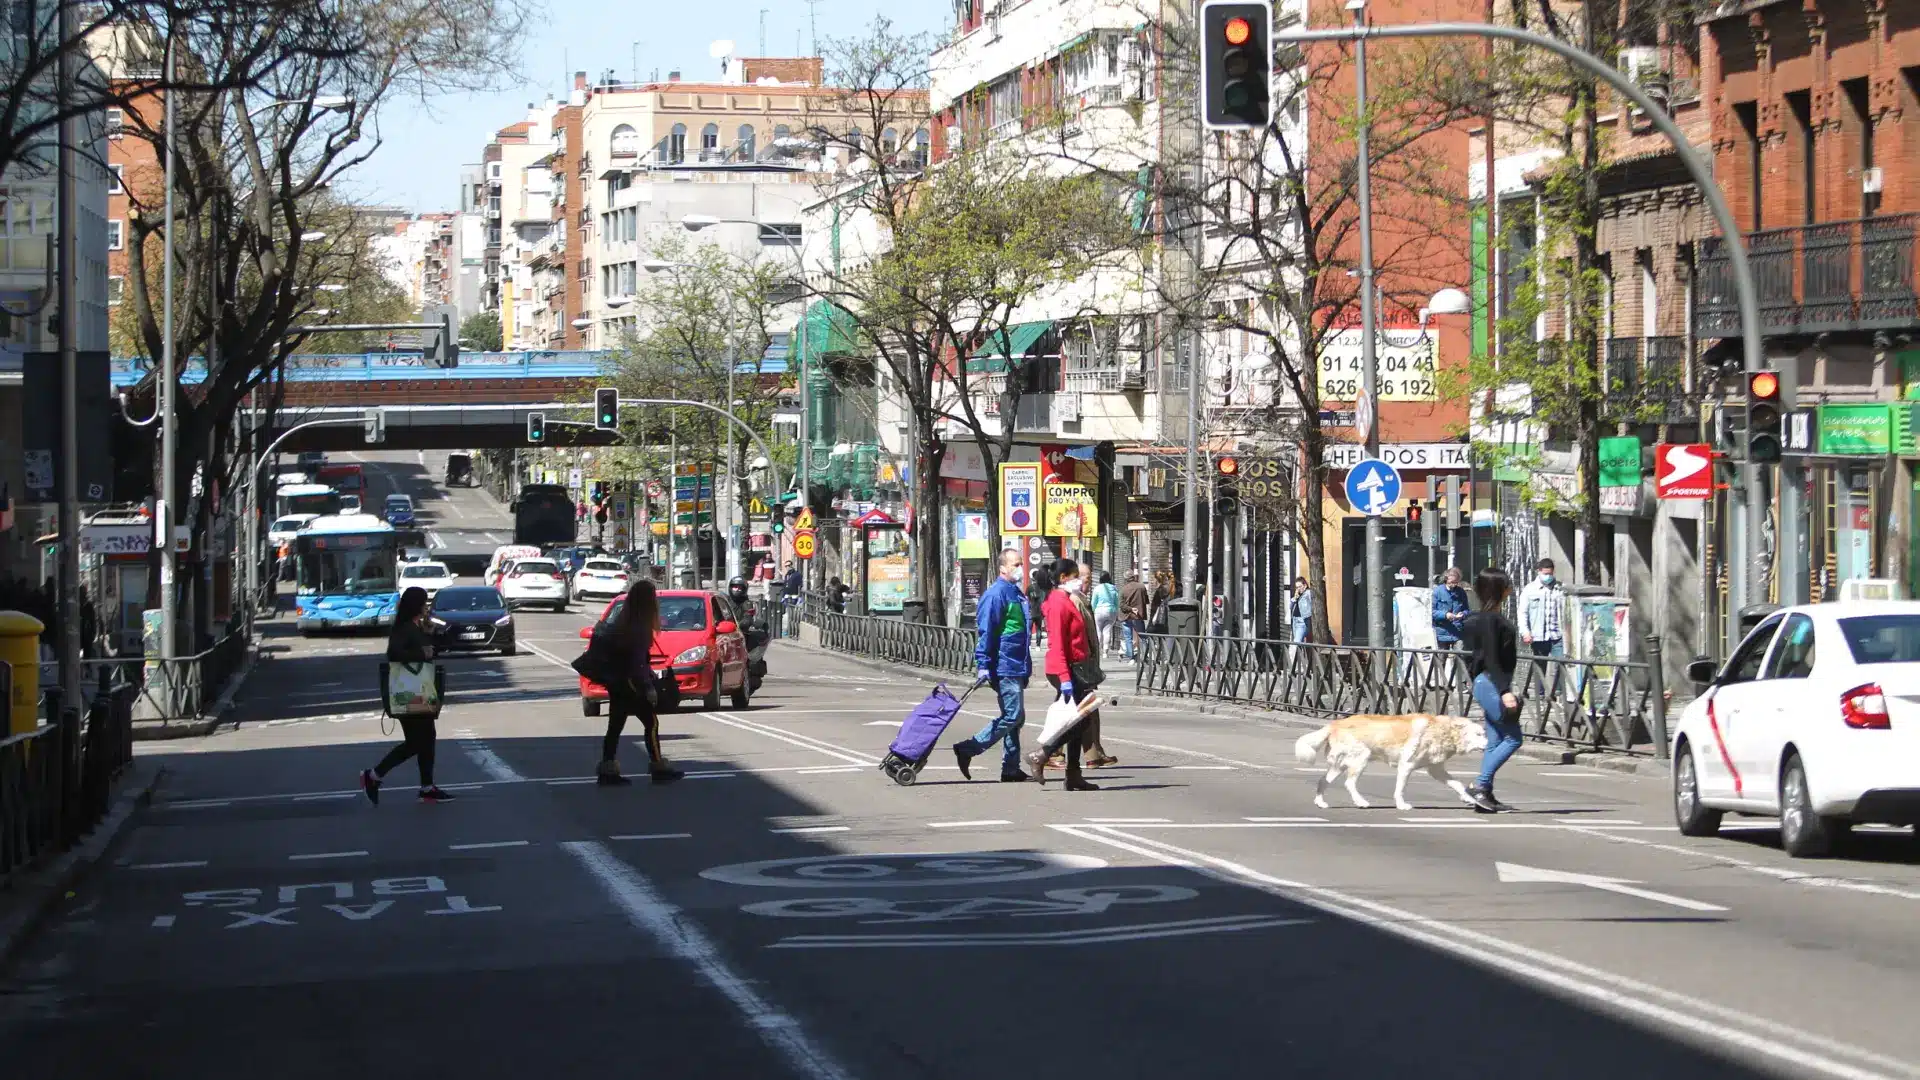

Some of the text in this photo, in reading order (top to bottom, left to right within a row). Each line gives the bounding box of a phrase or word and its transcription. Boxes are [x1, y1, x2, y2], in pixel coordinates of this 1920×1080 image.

[1402, 311, 1436, 325] PISS
[1323, 356, 1341, 371] 91
[1387, 356, 1407, 371] 04
[1326, 379, 1357, 395] 626
[1401, 379, 1431, 395] 192
[1334, 449, 1427, 464] HELDOS
[1600, 456, 1637, 468] odere
[1048, 487, 1096, 498] COMPRO
[798, 540, 813, 550] 30
[183, 876, 447, 908] BUS
[152, 896, 503, 929] TAXI
